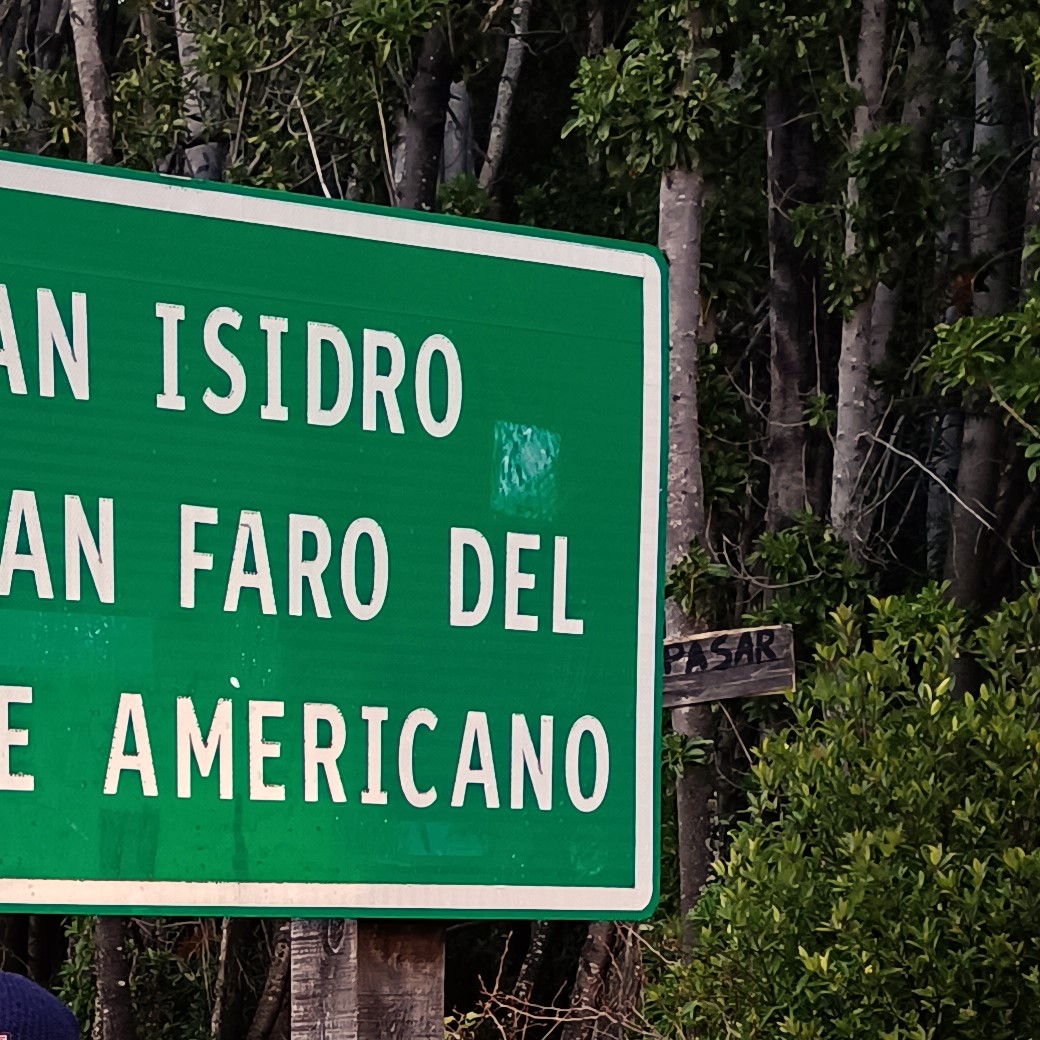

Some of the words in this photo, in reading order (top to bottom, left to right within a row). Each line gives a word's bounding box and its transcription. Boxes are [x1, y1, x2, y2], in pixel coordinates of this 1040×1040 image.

[155, 302, 463, 438] ISIDRO
[180, 503, 389, 621] FARO
[449, 527, 584, 636] DEL
[664, 630, 776, 674] PASAR
[103, 692, 610, 813] AMERICANO
